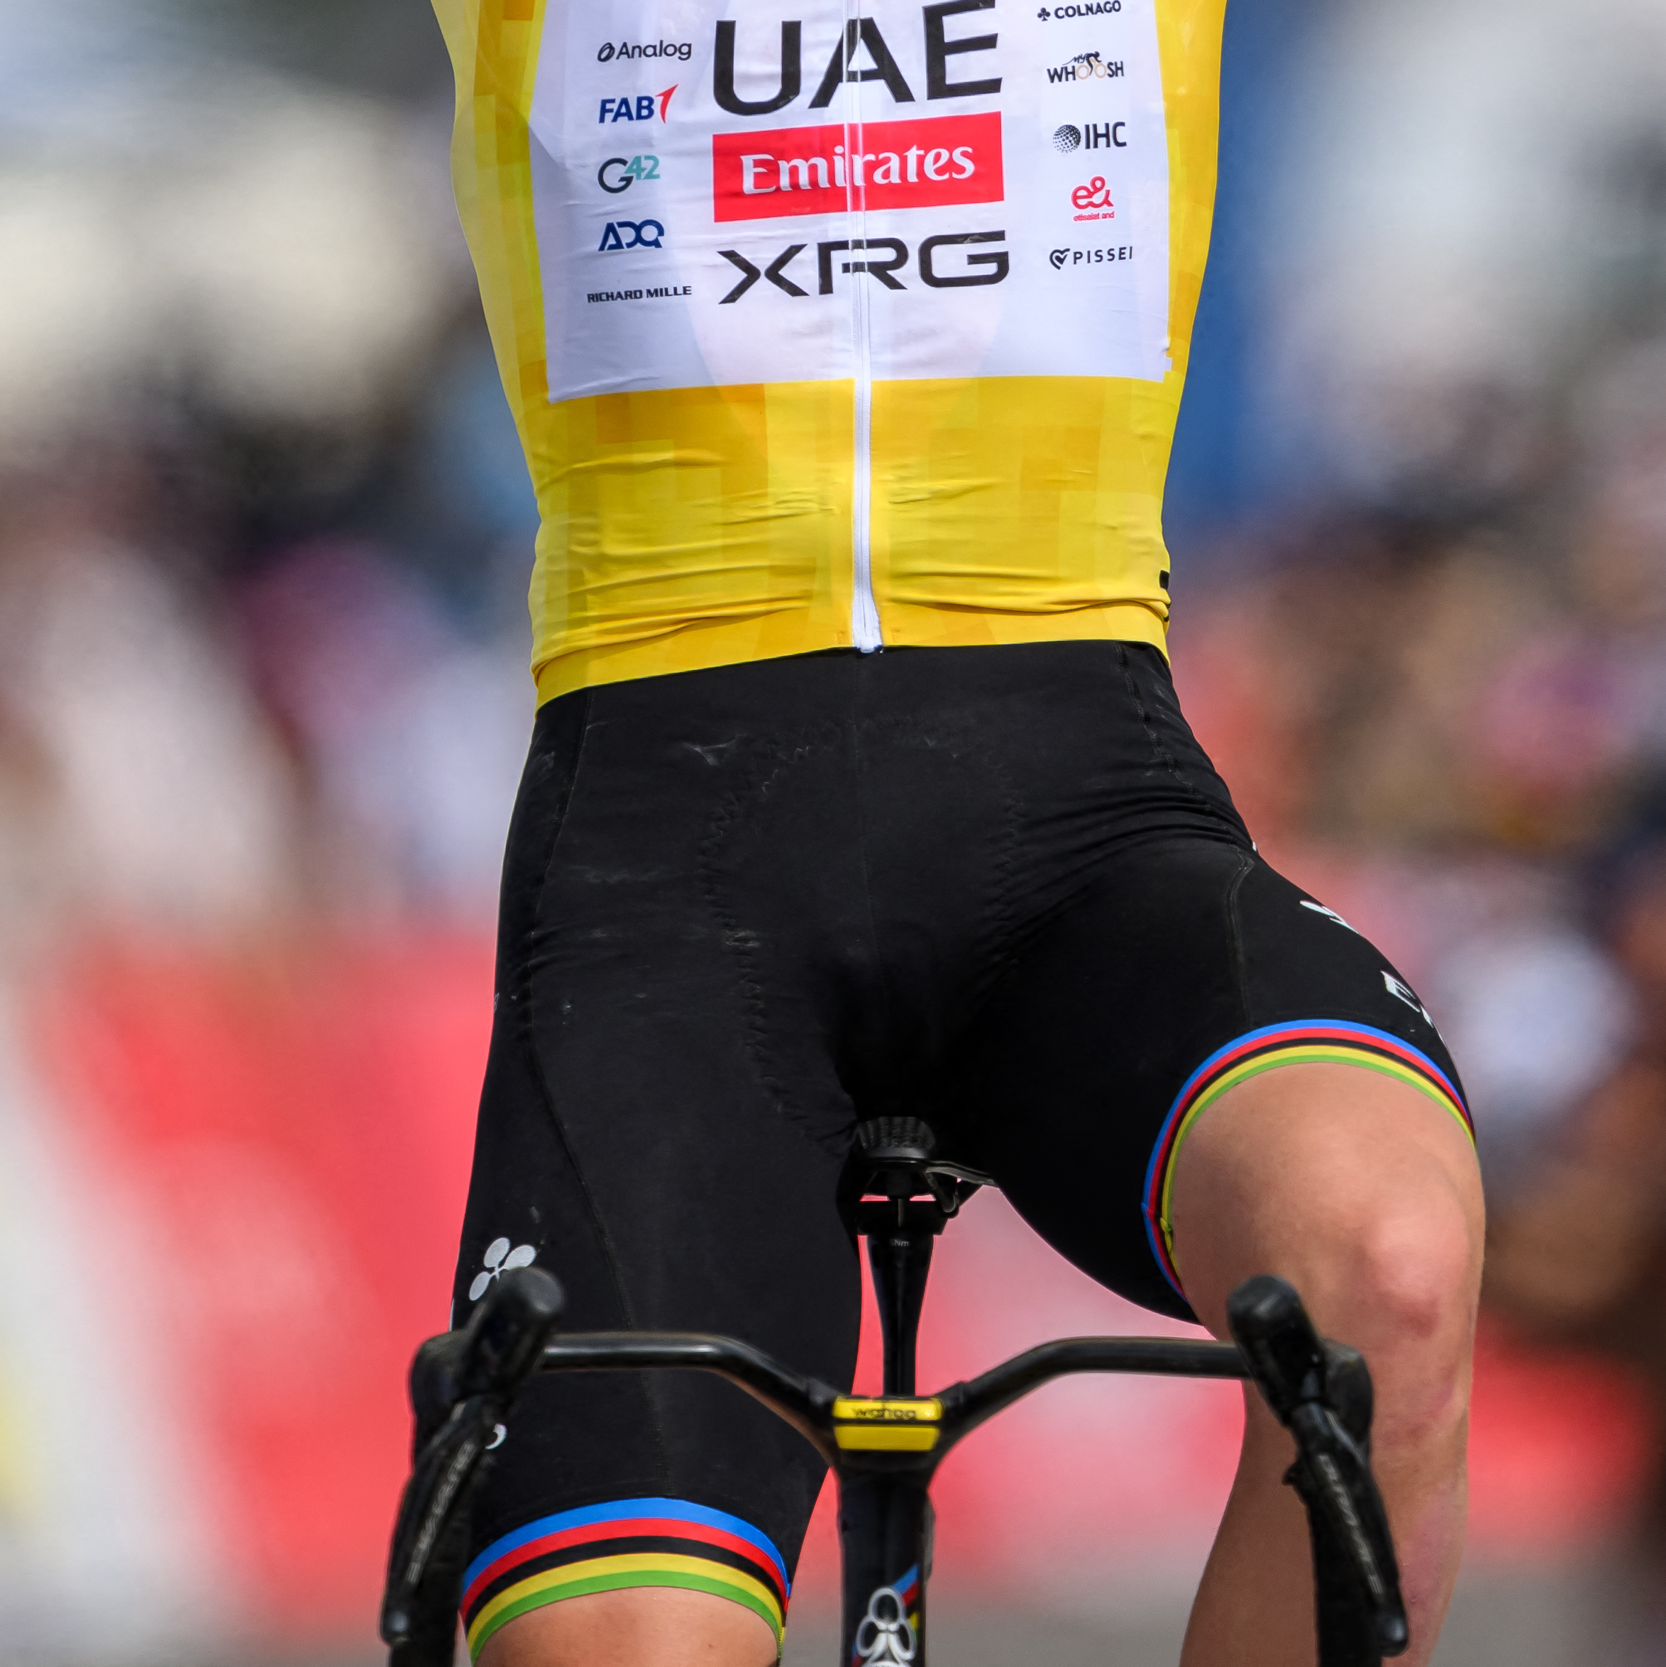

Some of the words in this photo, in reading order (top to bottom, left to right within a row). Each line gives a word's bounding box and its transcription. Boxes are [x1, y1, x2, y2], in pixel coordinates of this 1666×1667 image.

[1054, 0, 1122, 19] COLNAGO
[615, 39, 692, 61] Analog
[1084, 121, 1127, 149] IHC
[597, 154, 661, 194] G42
[739, 144, 976, 195] Emirates
[1101, 210, 1115, 220] and
[597, 218, 665, 251] ADQ
[716, 229, 1010, 305] XRG
[1073, 246, 1133, 265] PISSEI
[587, 289, 644, 304] RICHARD
[646, 285, 693, 299] MILLE
